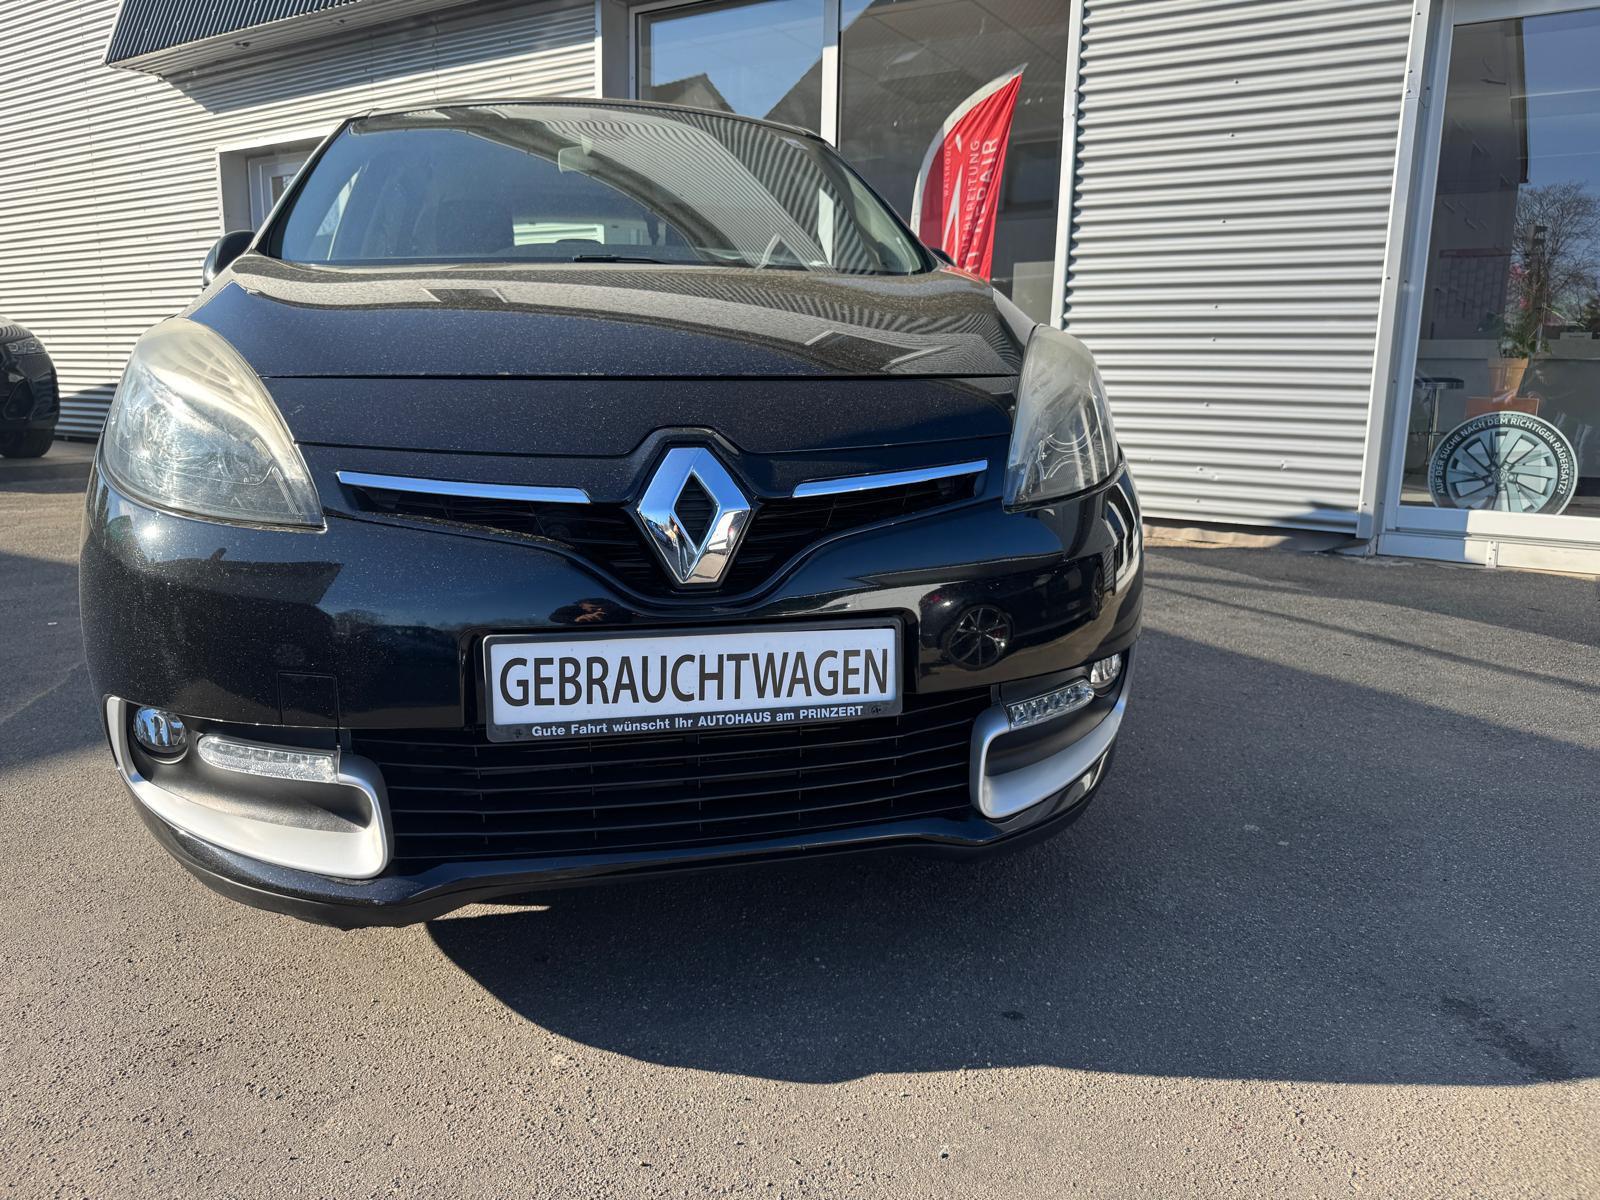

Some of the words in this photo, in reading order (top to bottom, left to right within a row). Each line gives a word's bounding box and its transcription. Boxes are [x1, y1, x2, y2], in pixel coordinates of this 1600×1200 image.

[1461, 421, 1486, 438] NACH
[1488, 418, 1509, 426] DEM
[1510, 418, 1557, 444] RICHTIGEN
[1440, 435, 1461, 461] SUCHE
[1435, 460, 1445, 475] DER
[1552, 441, 1570, 495] RÄDERSATZ?
[1434, 477, 1445, 494] AUF
[500, 648, 888, 707] GEBRAUCHTWAGEN
[531, 725, 566, 737] Gute
[571, 722, 608, 735] Fahrt
[613, 718, 671, 732] wünscht
[674, 717, 694, 729] Ihr
[698, 711, 771, 727] AUTOHAUS
[776, 712, 795, 722] am
[799, 705, 864, 720] PRINZERT
